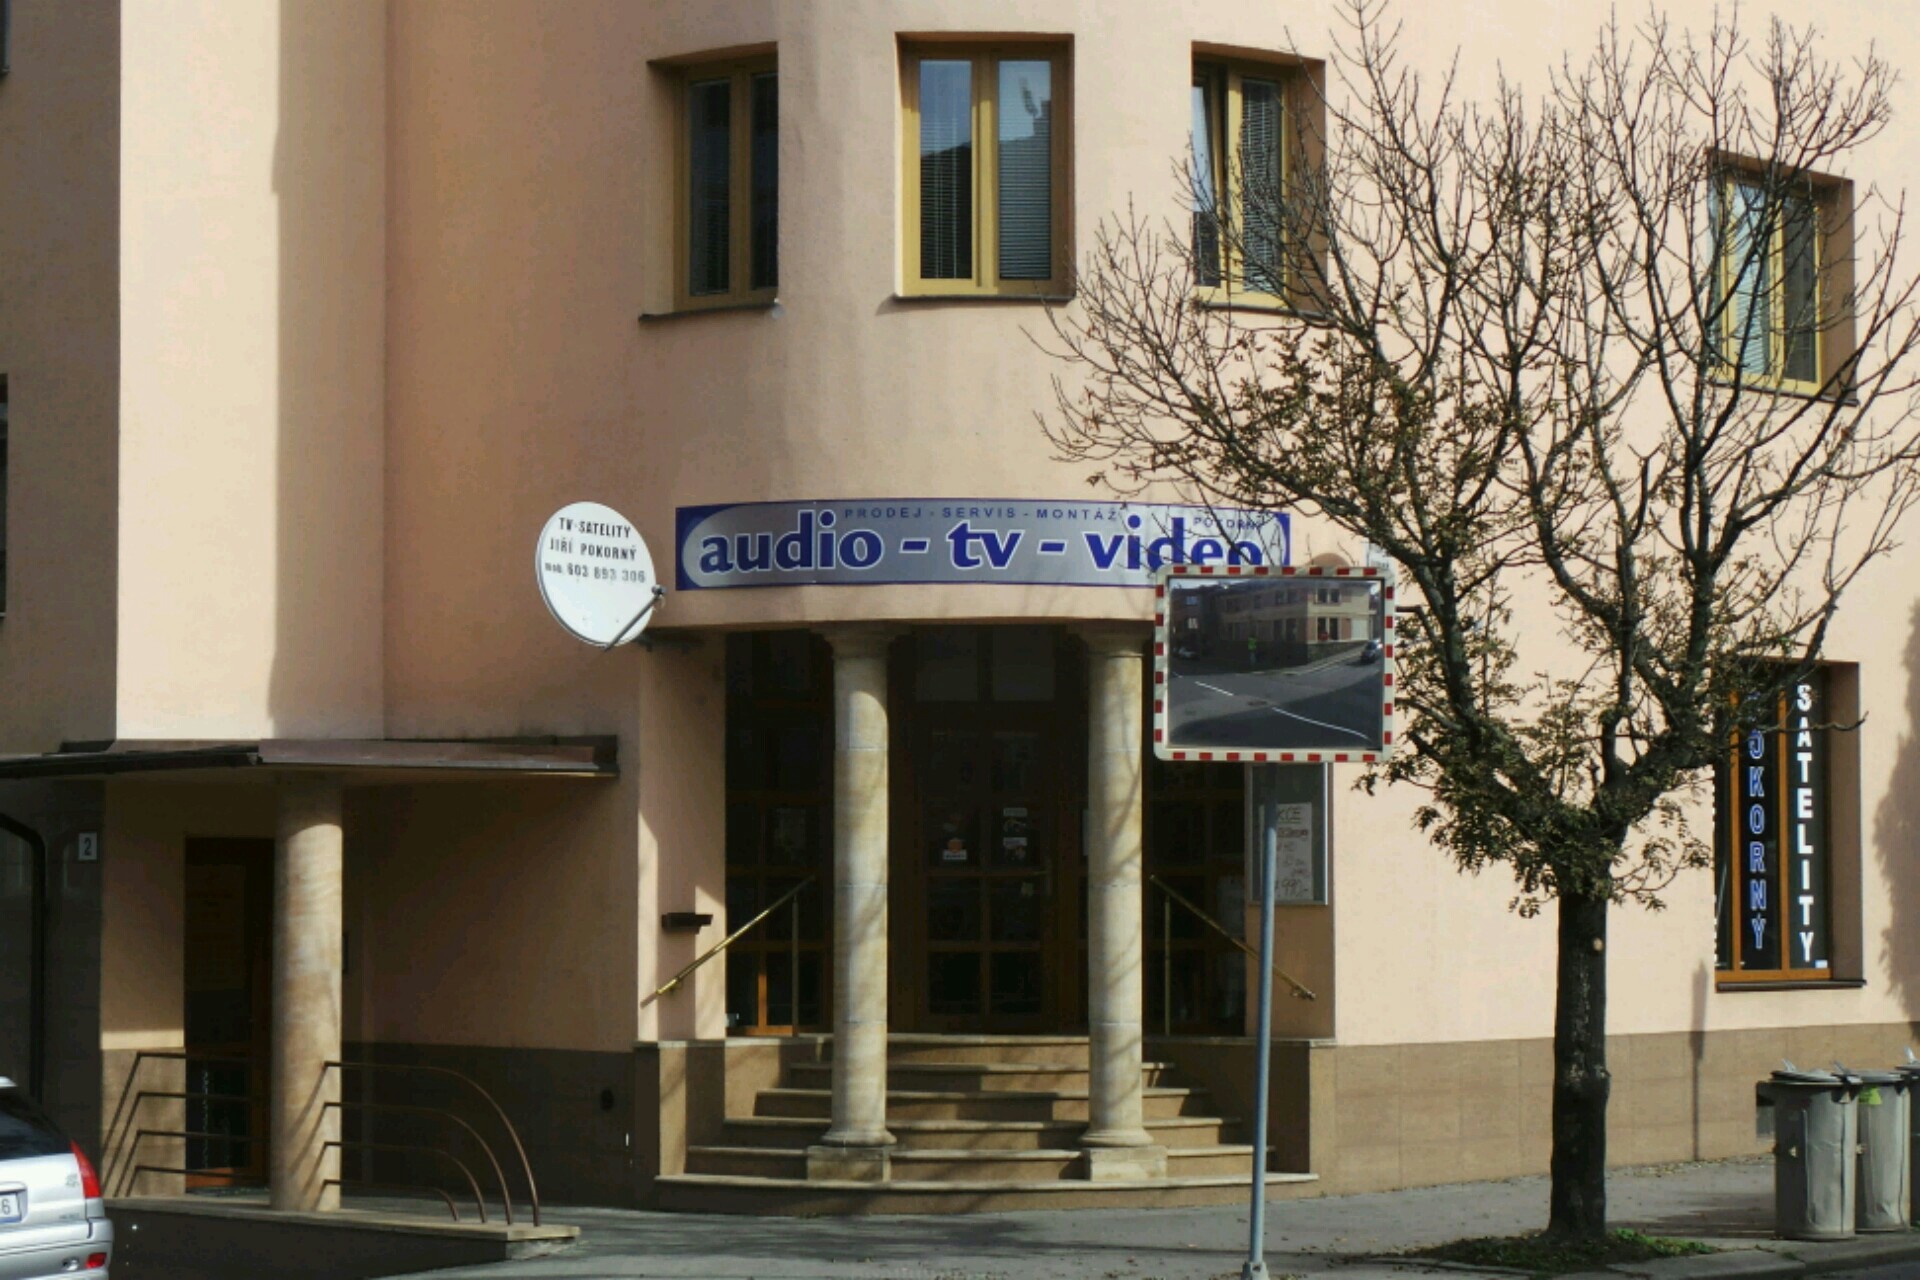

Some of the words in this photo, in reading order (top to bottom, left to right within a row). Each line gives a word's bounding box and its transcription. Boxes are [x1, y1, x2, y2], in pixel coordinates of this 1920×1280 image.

[845, 507, 922, 519] PRODEJ
[942, 507, 1016, 518] SERVIS
[1036, 508, 1117, 522] MONTÁŽ
[580, 543, 637, 560] POKORNÝ
[700, 510, 884, 574] audio
[946, 519, 1025, 569] tv
[1083, 514, 1263, 572] video
[1797, 684, 1814, 962] SATELITY
[84, 837, 92, 856] 2
